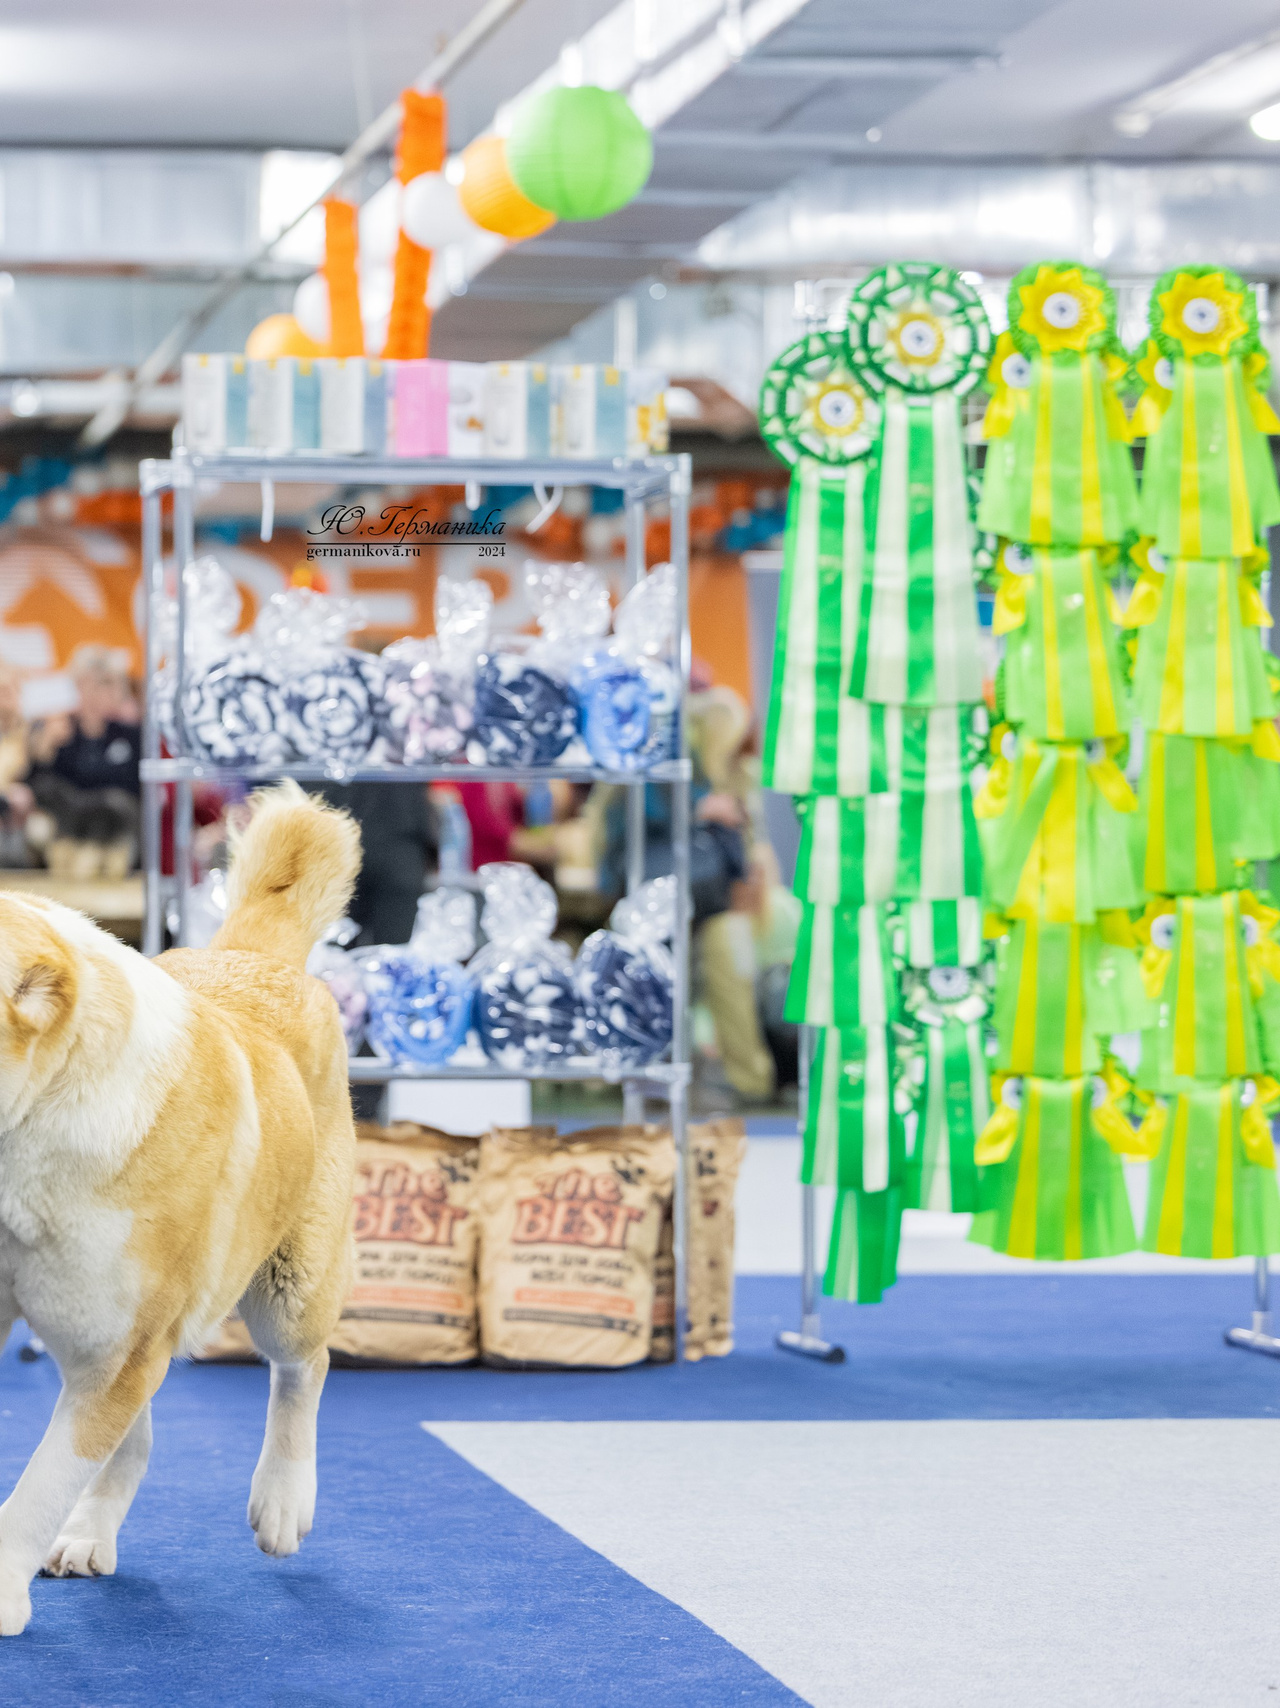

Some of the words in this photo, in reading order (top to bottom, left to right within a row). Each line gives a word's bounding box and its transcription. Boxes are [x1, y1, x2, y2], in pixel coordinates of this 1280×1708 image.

[358, 1161, 448, 1200] The
[534, 1167, 623, 1204] The
[354, 1197, 470, 1247] BEST
[511, 1199, 645, 1250] BEST
